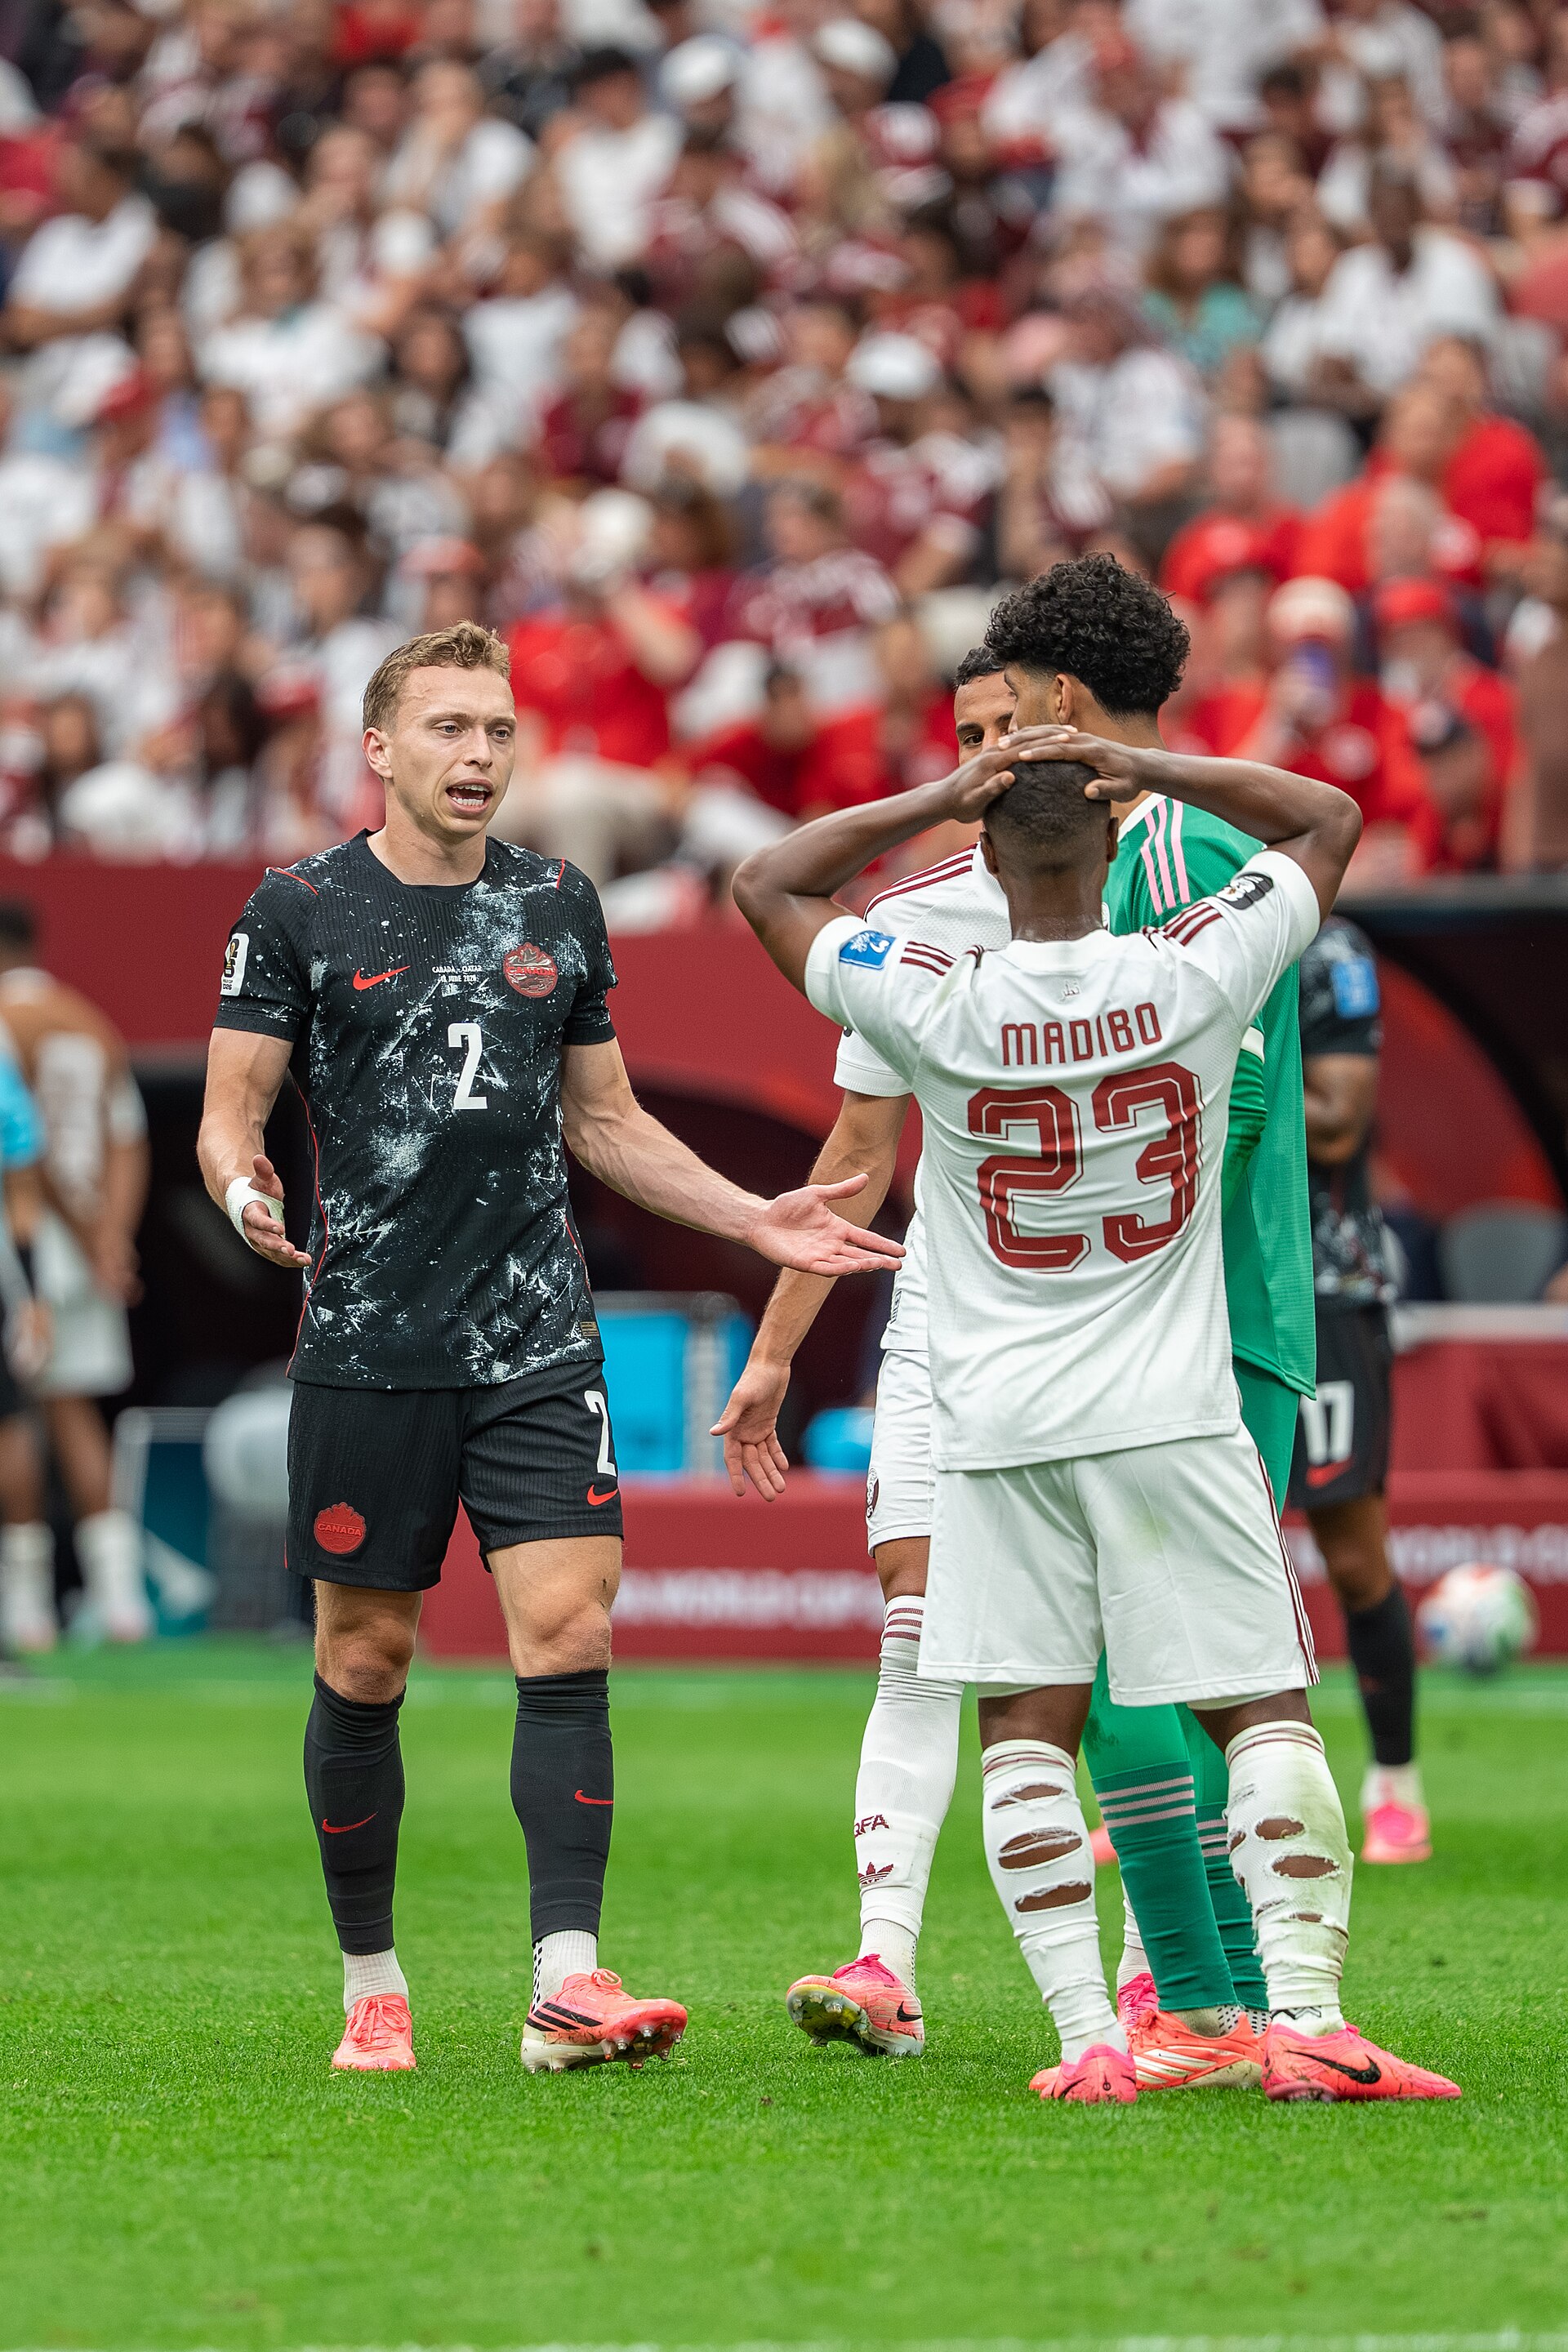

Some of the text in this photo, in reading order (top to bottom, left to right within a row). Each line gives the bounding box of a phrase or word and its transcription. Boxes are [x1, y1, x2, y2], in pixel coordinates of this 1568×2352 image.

[461, 964, 482, 973] QATAR
[506, 966, 555, 977] CANADA
[447, 1022, 488, 1111] 2
[1001, 1001, 1163, 1066] MADIBO
[967, 1061, 1206, 1274] 23
[584, 1389, 617, 1477] 2
[1299, 1379, 1356, 1467] 17
[317, 1523, 362, 1536] CANADA
